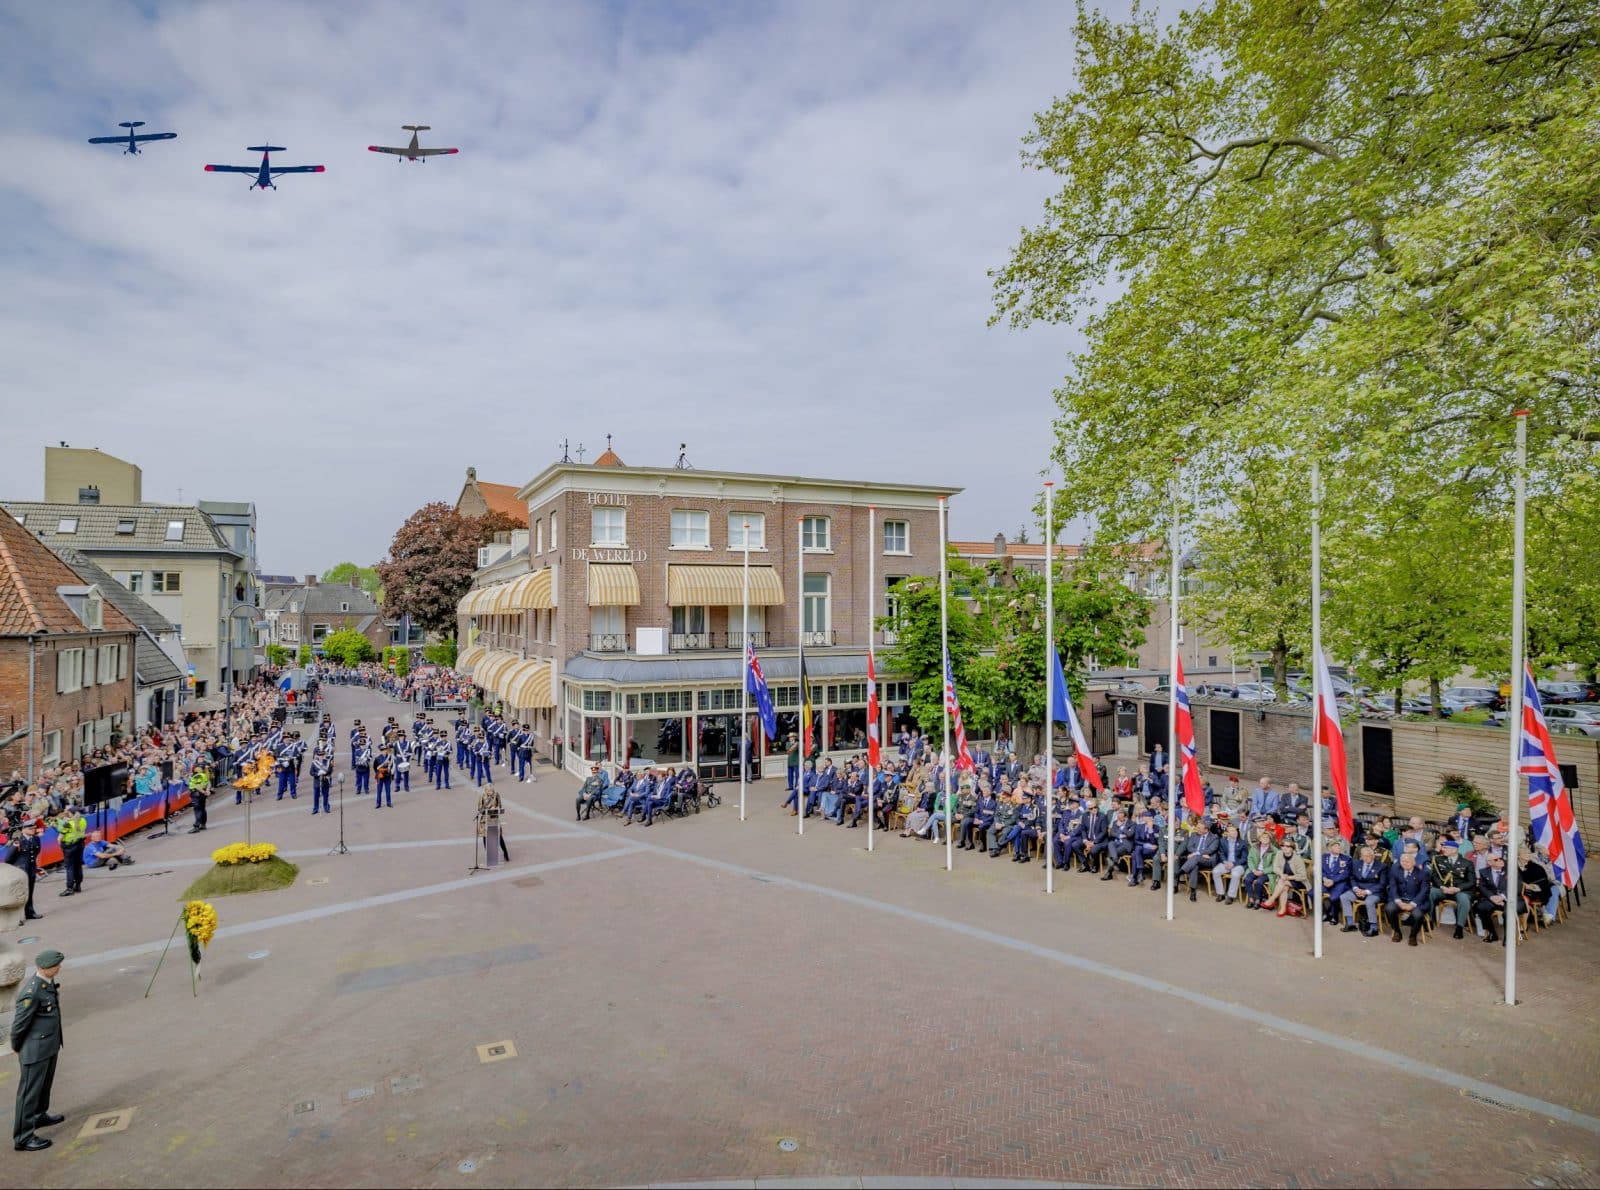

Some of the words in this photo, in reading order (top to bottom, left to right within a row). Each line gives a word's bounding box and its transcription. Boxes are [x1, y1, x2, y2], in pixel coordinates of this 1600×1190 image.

[588, 492, 632, 506] HOTEL
[572, 548, 589, 560] DE
[592, 549, 647, 561] WERELD
